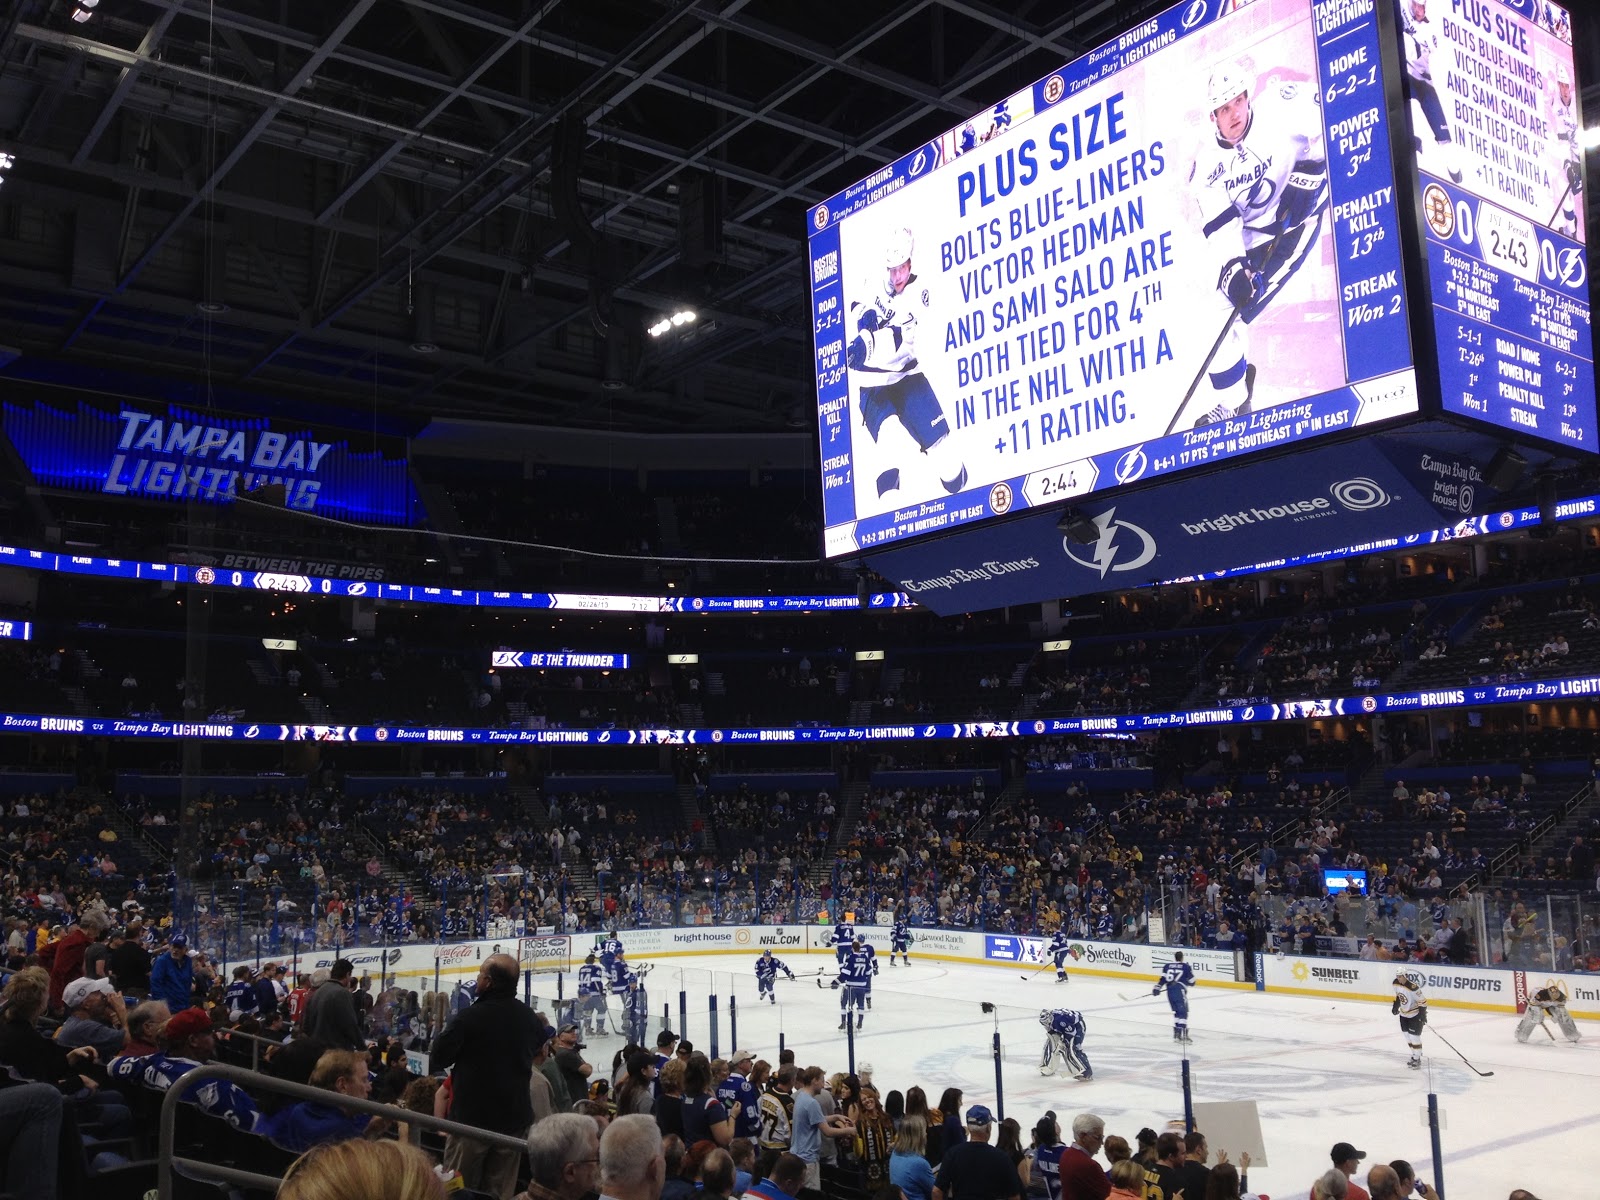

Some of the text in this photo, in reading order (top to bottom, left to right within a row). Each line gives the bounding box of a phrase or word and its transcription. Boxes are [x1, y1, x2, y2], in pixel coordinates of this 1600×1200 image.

[1316, 1, 1374, 36] LIGHTNING
[1088, 19, 1158, 65] Boston BRUINS
[1496, 13, 1528, 55] SIZE
[1070, 28, 1176, 92] Tampa Bay LIGHTNING
[1329, 46, 1368, 77] HOME
[1443, 17, 1543, 90] BOLTS BLUE-LINERS
[1326, 65, 1377, 103] 6-2-1
[1454, 48, 1537, 110] VICTOR HEDMAN
[1447, 71, 1548, 140] AND SAMI SALO ARE
[1330, 107, 1380, 141] POWER
[1455, 100, 1530, 155] BOTH TIED FOR
[957, 91, 1127, 218] PLUS SIZE
[1339, 127, 1374, 155] PLAY
[1454, 124, 1541, 184] IN THE NHL WITH
[866, 166, 893, 190] BRUINS
[1255, 156, 1274, 179] BAY
[866, 176, 905, 204] LIGHTNING
[941, 141, 1165, 272] BOLTS BLUE-LINERS
[1334, 186, 1392, 223] PENALTY
[1350, 210, 1380, 235] KILL
[1456, 200, 1474, 244] 0
[960, 196, 1145, 304] VICTOR HEDMAN
[1350, 228, 1385, 260] 13th
[1491, 230, 1557, 281] 2:43 0
[1444, 250, 1499, 284] Boston Bruins
[945, 230, 1174, 352] AND SAMI SALO ARE
[1344, 270, 1398, 302] STREAK
[818, 296, 837, 314] ROAD
[1348, 301, 1385, 328] Won
[1513, 278, 1591, 325] Tampa Lightning
[816, 310, 842, 334] 5-1-1
[957, 300, 1119, 388] BOTH TIED FOR
[1457, 326, 1482, 346] 5-1-1
[818, 340, 842, 360] POWER
[822, 355, 839, 370] PLAY
[956, 328, 1174, 430] IN THE NHL WITH A
[1498, 360, 1542, 388] POWER PLAY
[819, 395, 848, 417] PENALTY
[1463, 392, 1481, 412] Won
[1499, 382, 1528, 405] PENALTY
[995, 389, 1136, 454] +11 RATING.
[1183, 402, 1313, 447] Tampa Bay Lightning
[1238, 409, 1350, 450] SOUTHEAST EAST
[1510, 407, 1538, 429] STREAK
[118, 409, 333, 473] TAMPA BAY
[824, 453, 850, 472] STREAK
[1421, 454, 1452, 478] Tampa
[1452, 462, 1468, 482] Bay
[1432, 492, 1458, 507] house
[1434, 480, 1458, 496] bright
[1181, 495, 1330, 538] bright house
[1293, 510, 1338, 523] NETWORKS
[223, 554, 301, 574] BETWEEN
[305, 562, 337, 577] THE
[338, 566, 386, 581] PIPES
[901, 556, 1040, 592] Tampa Bay Times
[232, 572, 332, 592] 0 0
[708, 598, 824, 609] Boston BRUINS Tampa Bay
[531, 654, 614, 667] BE THE THUNDER
[1386, 683, 1558, 708] Boston BRUINS Tampa Bay
[4, 716, 234, 738] Boston BRUINS Tampa Bay LIGHTNING
[731, 726, 915, 742] Boston BRUINS Tampa Bay LIGHTNING
[1053, 710, 1234, 731] Boston BRUINS Tampa Bay LIGHTNING
[396, 729, 589, 743] Boston BRUINS Tampa Bay LIGHTNING
[524, 938, 548, 950] ROSE
[604, 942, 616, 952] 16
[674, 932, 732, 943] bright house
[760, 935, 800, 945] NHL.COM
[1086, 944, 1136, 968] Sweetbay
[853, 963, 867, 977] 77
[1165, 969, 1184, 982] 67
[1312, 966, 1359, 981] SUNBELT
[1428, 974, 1502, 992] SUN SPORTS
[1516, 970, 1526, 1005] Reebok
[1576, 988, 1594, 1000] i'm
